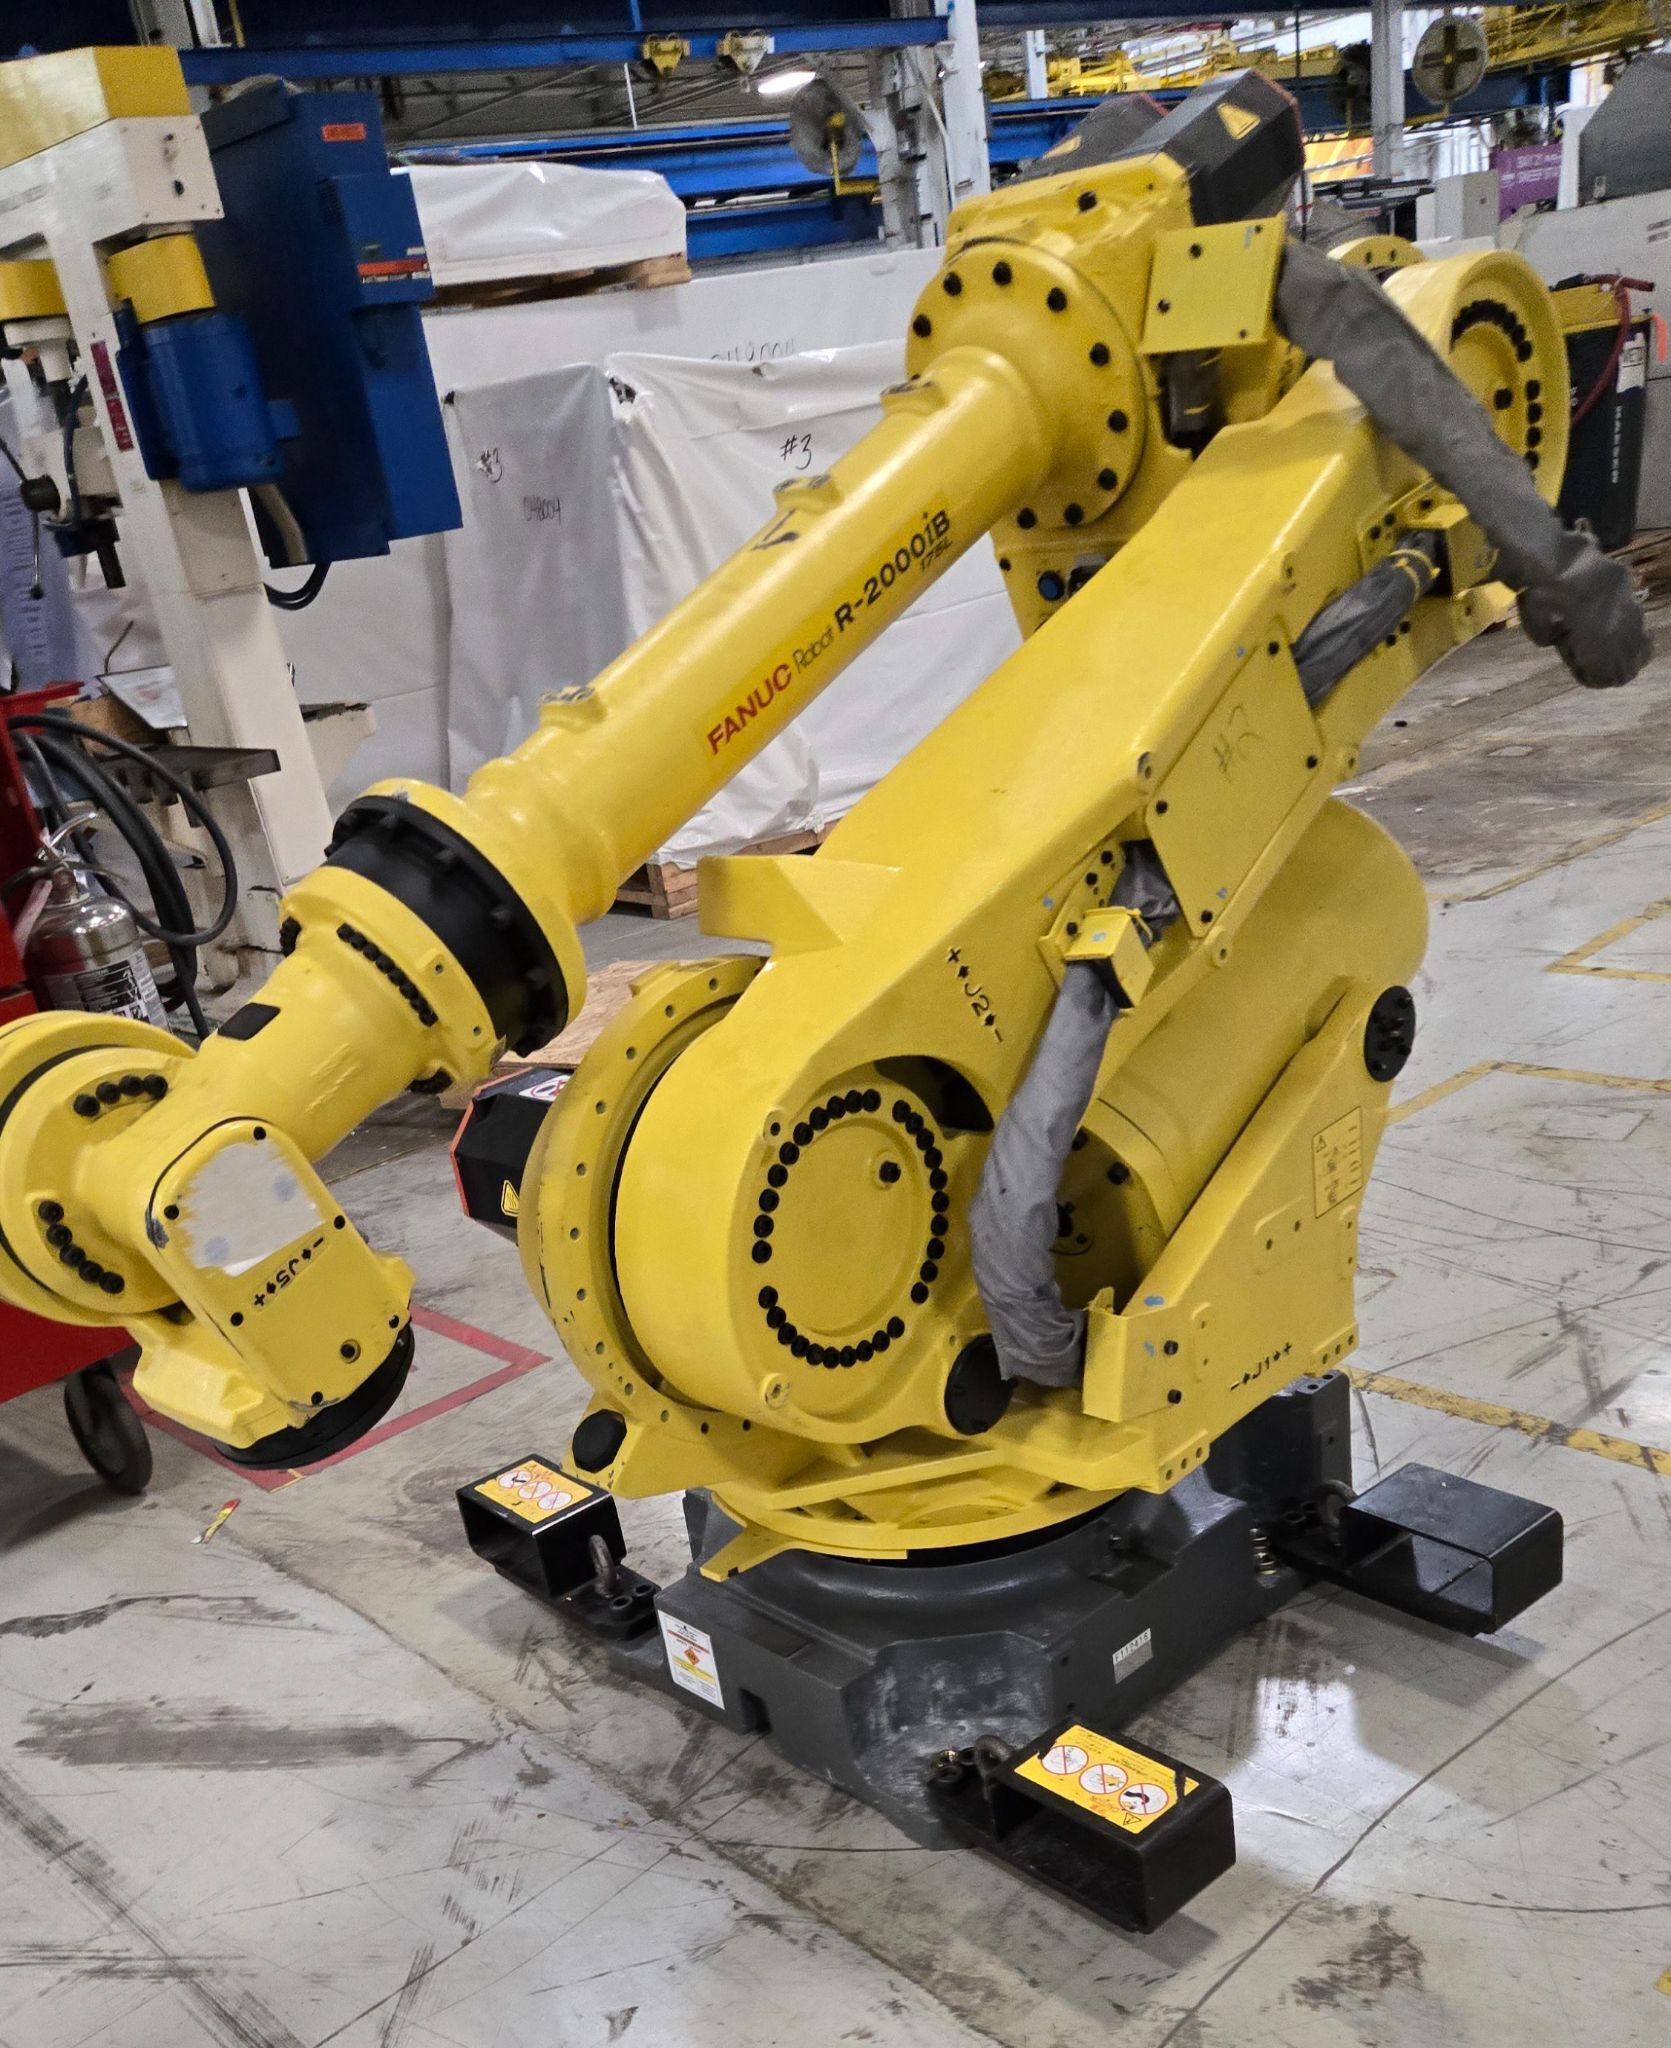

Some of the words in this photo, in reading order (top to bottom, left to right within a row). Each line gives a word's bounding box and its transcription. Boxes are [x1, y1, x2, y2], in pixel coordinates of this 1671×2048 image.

[780, 433, 812, 470] #3
[707, 663, 792, 755] FANUC
[792, 625, 835, 674] Robot
